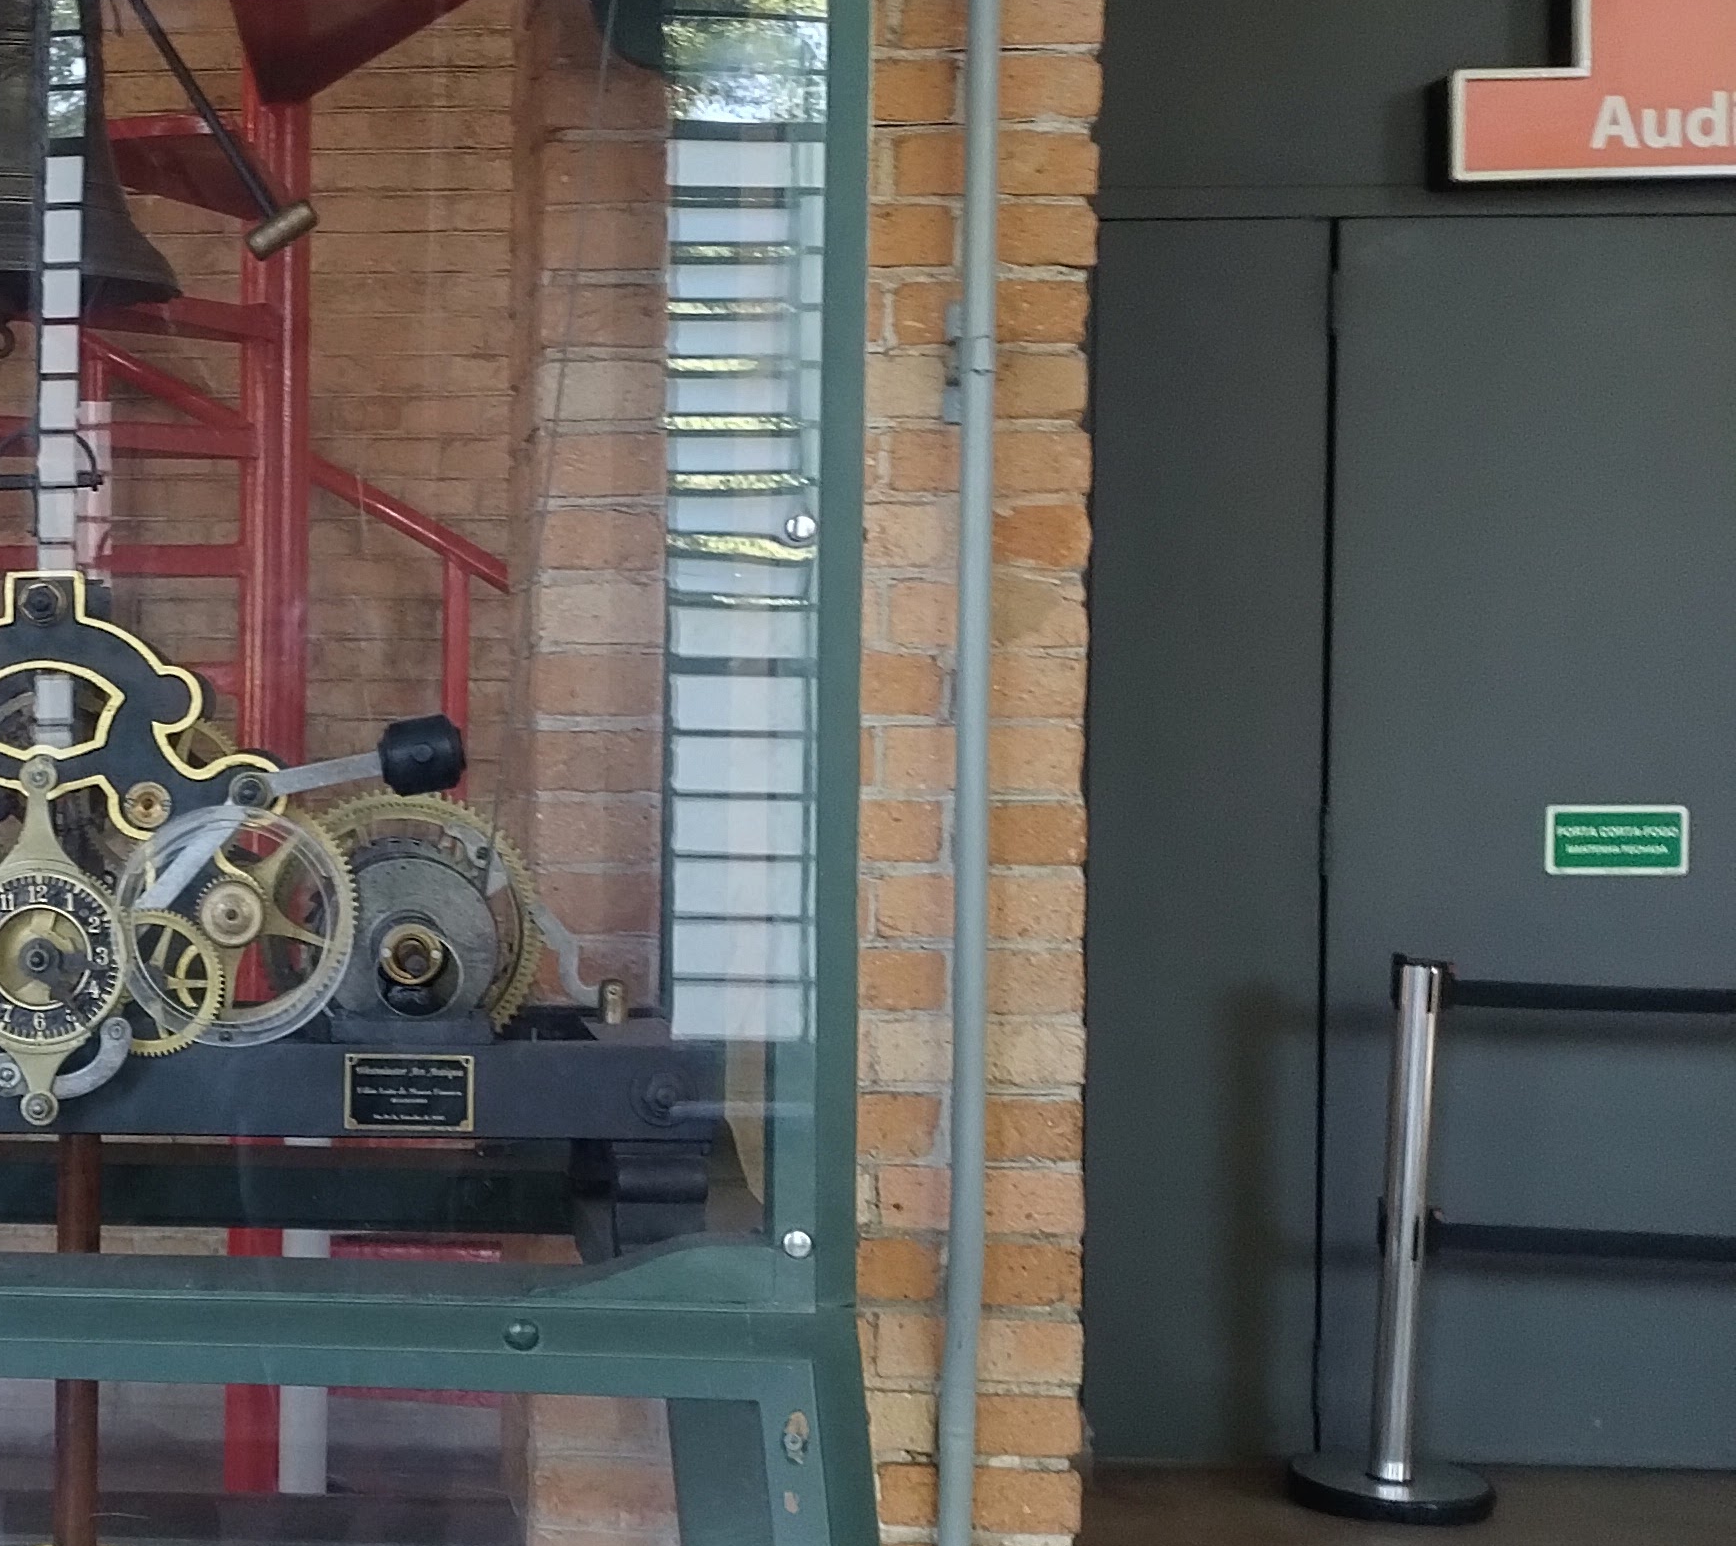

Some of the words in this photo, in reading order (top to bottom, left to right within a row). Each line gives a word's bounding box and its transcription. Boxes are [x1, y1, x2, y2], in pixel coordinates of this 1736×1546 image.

[0, 893, 15, 911] 11
[27, 885, 48, 903] 12
[65, 893, 74, 911] 1
[88, 916, 101, 934] 2
[96, 947, 109, 965] 3
[85, 980, 101, 998] 4
[1, 1004, 14, 1023] 7
[33, 1012, 46, 1030] 6
